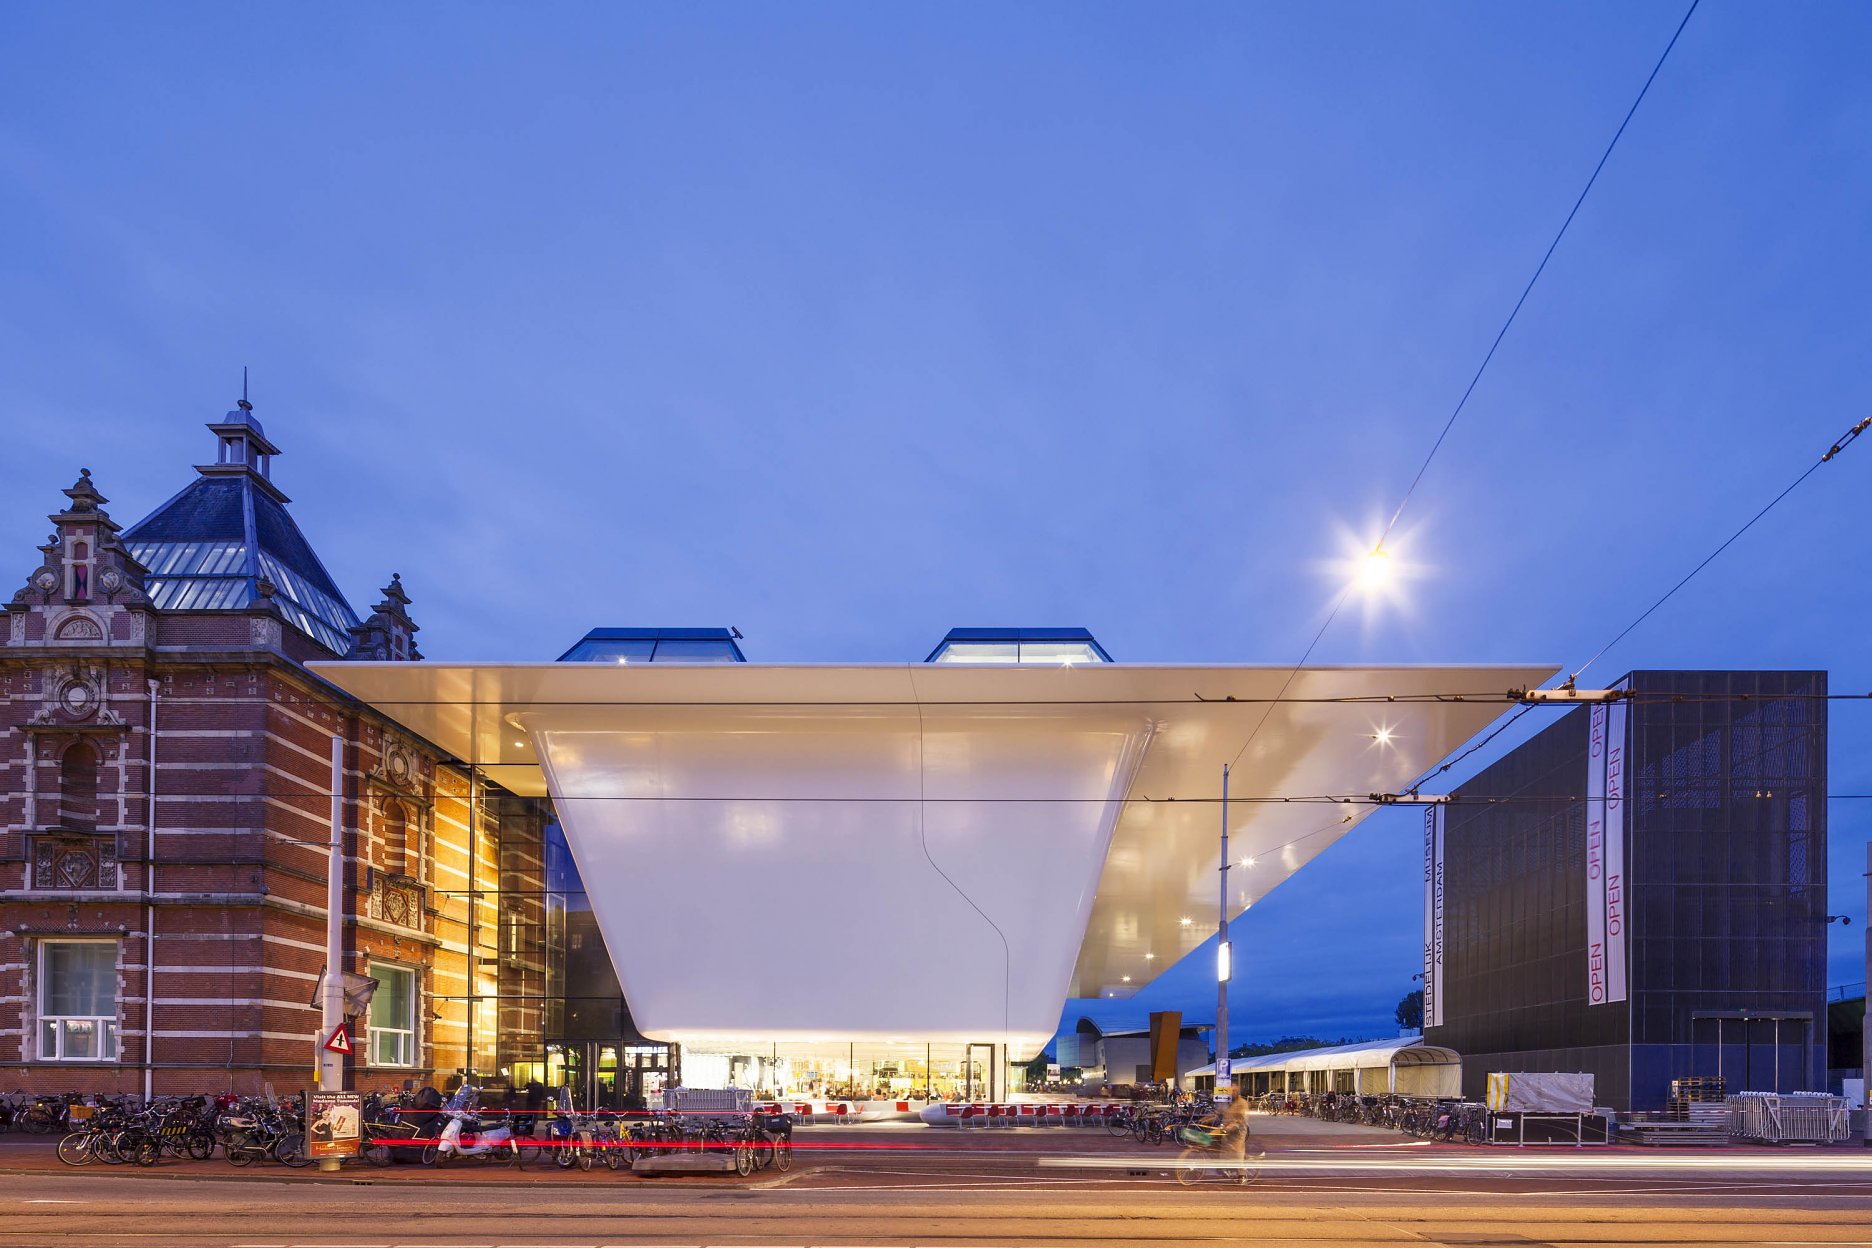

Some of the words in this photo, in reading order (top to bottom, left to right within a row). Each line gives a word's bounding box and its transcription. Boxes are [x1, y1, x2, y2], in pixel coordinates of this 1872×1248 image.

[1608, 747, 1621, 810] OPEN
[1425, 809, 1433, 883] MUSEUM
[1588, 820, 1601, 880] OPEN
[1608, 874, 1621, 936] OPEN
[1590, 942, 1603, 1002] OPEN
